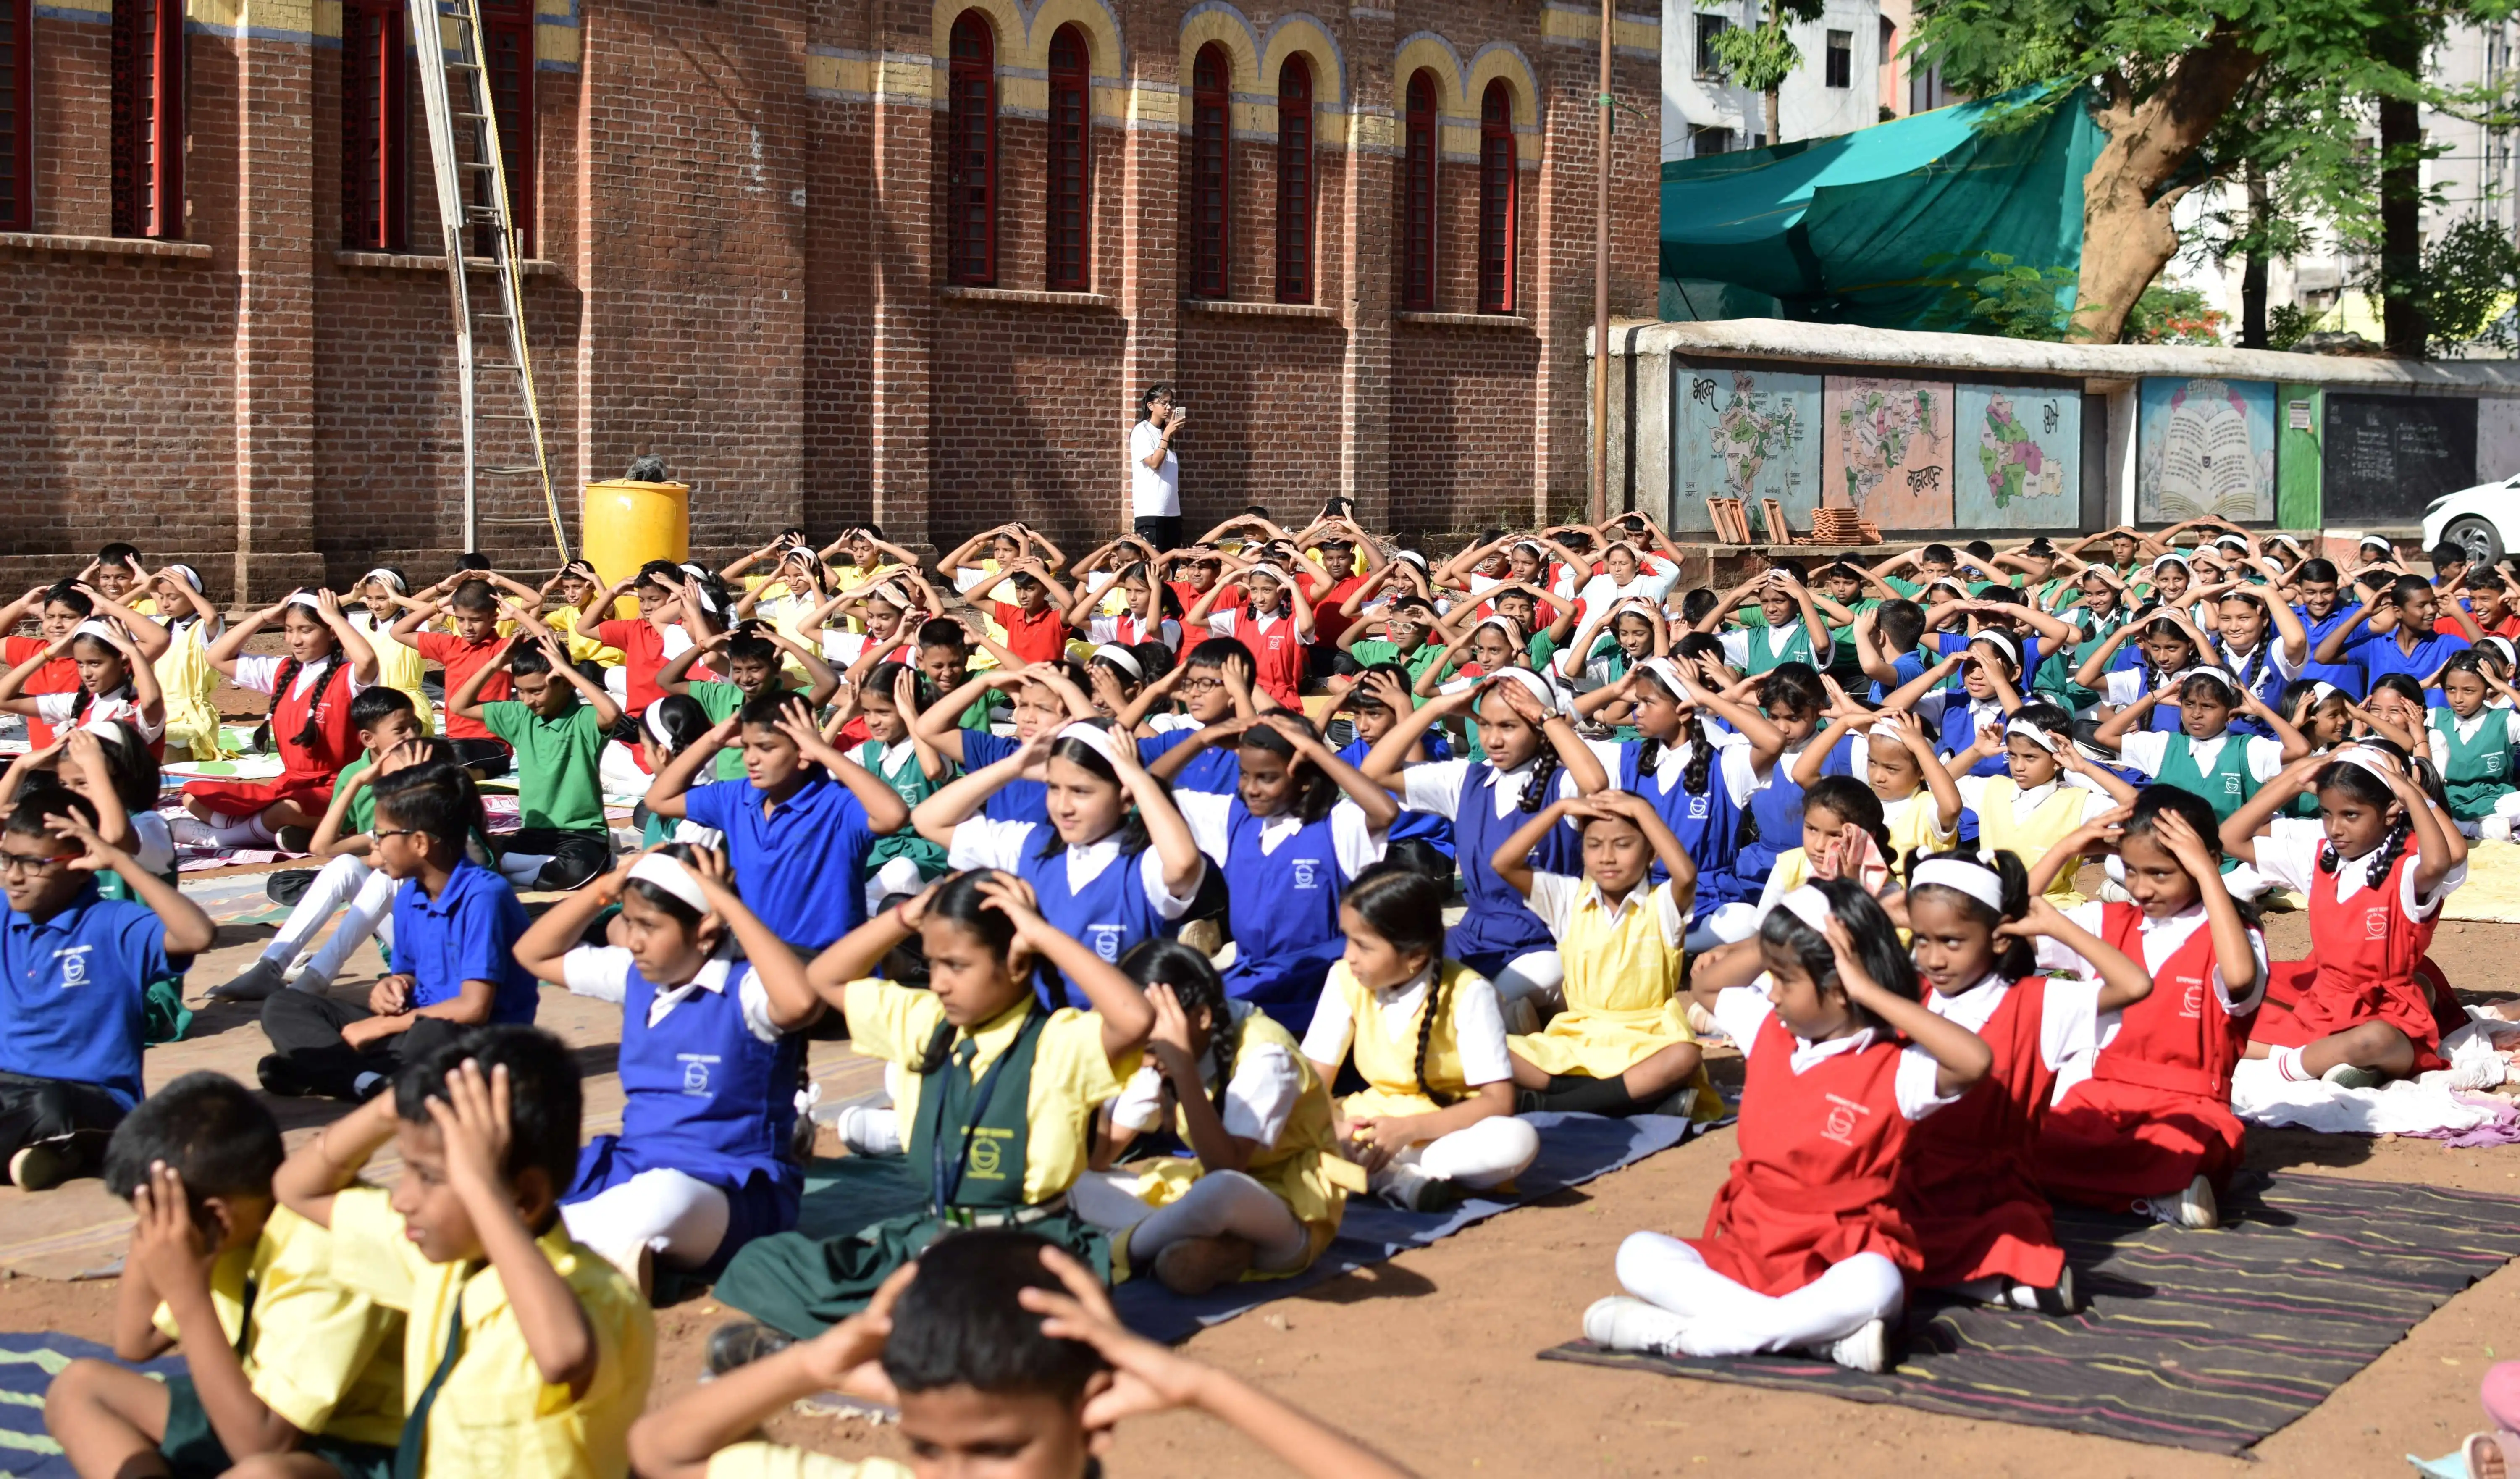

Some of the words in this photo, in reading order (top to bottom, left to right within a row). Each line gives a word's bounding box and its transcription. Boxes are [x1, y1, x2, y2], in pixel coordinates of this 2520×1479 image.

[1693, 377, 1719, 412] भारत
[2043, 399, 2059, 434] पुणे
[1907, 465, 1943, 498] महाराष्ट्र
